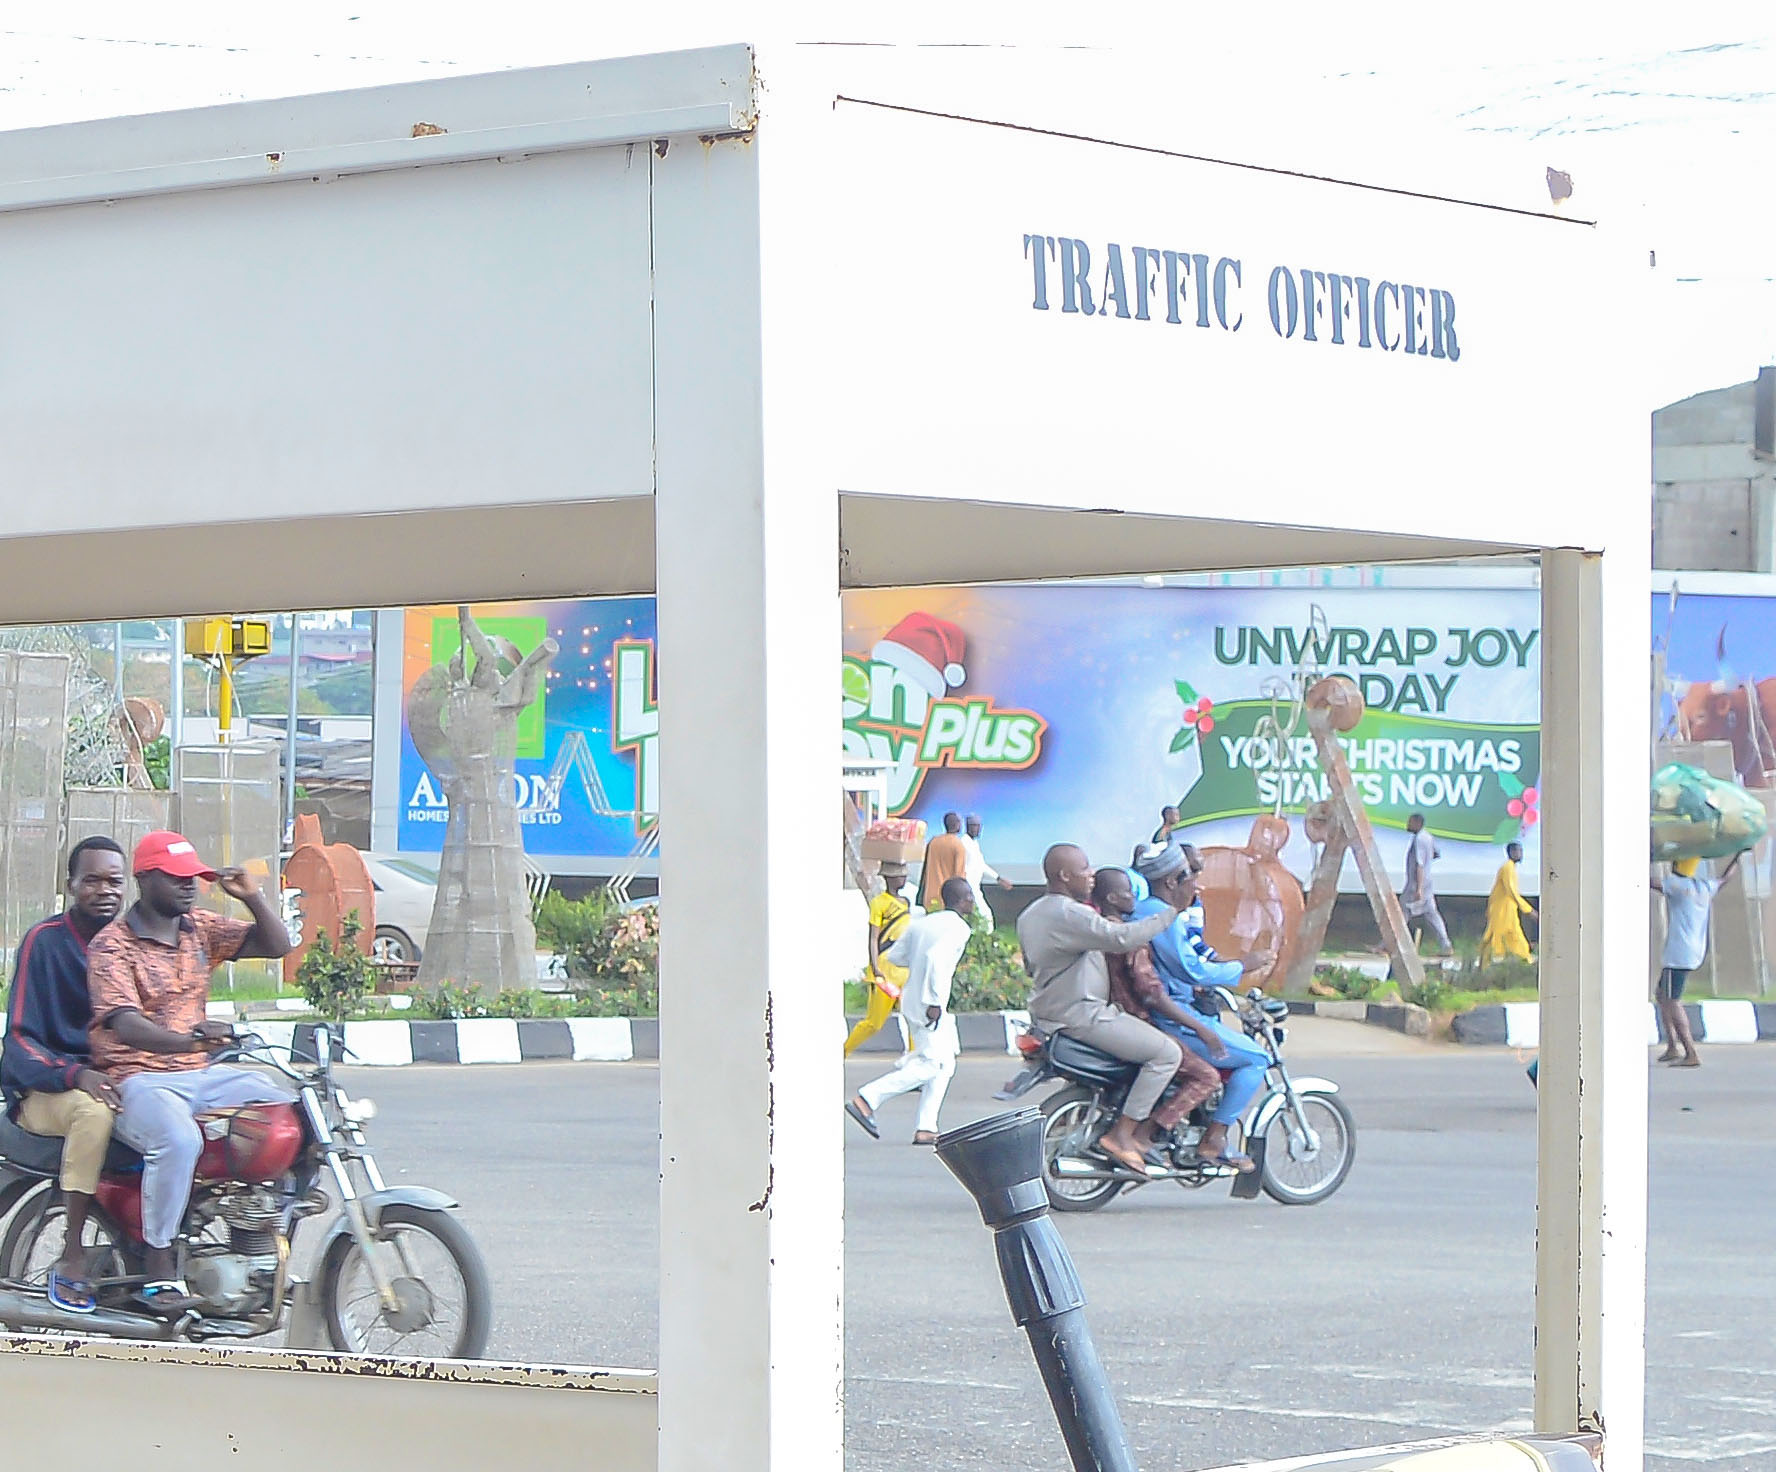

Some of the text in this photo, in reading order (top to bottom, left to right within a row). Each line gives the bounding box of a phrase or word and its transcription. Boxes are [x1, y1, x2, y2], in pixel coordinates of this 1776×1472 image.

[1023, 233, 1461, 362] TRAFFIC OFFICER
[1214, 626, 1539, 668] UNWRAP JOY
[919, 702, 1040, 762] Plus
[1220, 735, 1319, 769] YOUR
[1390, 773, 1484, 808] NOW
[538, 812, 562, 825] LTD
